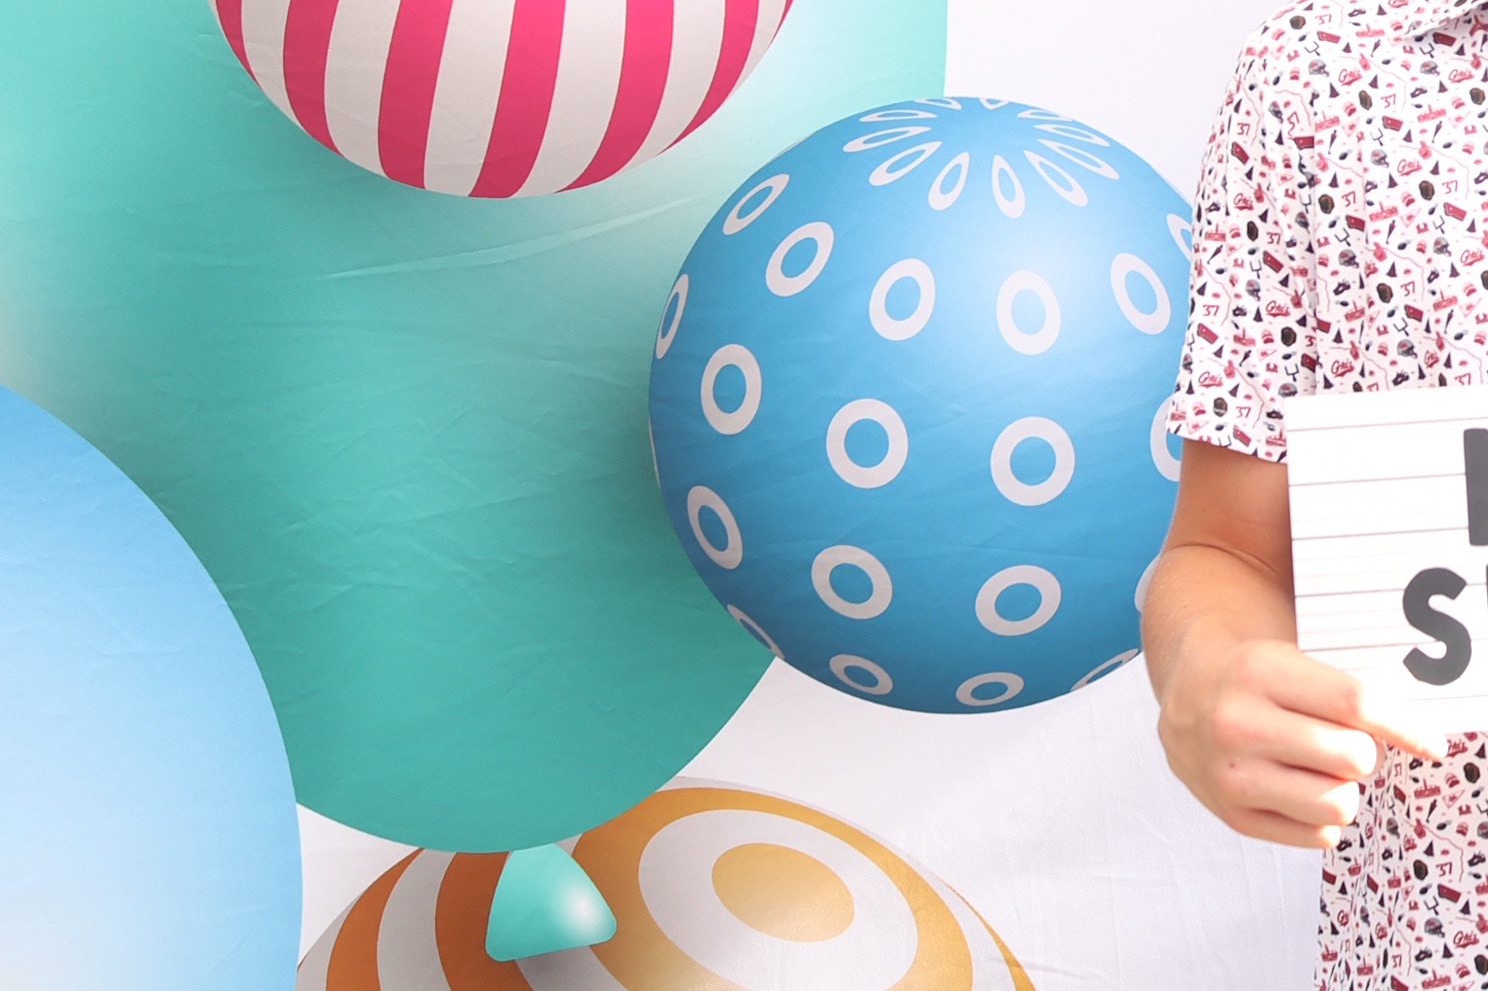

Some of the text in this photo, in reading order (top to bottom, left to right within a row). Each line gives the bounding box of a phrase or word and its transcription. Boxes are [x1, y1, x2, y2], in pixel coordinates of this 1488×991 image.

[1316, 13, 1333, 25] 37
[1379, 92, 1397, 109] 37
[1236, 121, 1252, 137] 37
[1441, 179, 1459, 195] 37
[1341, 189, 1358, 208] 37
[1266, 230, 1283, 246] 37
[1400, 279, 1417, 298] 37
[1202, 303, 1221, 317] 37
[1454, 371, 1473, 387] 37
[1235, 404, 1253, 420] 37
[1435, 859, 1454, 879] 37
